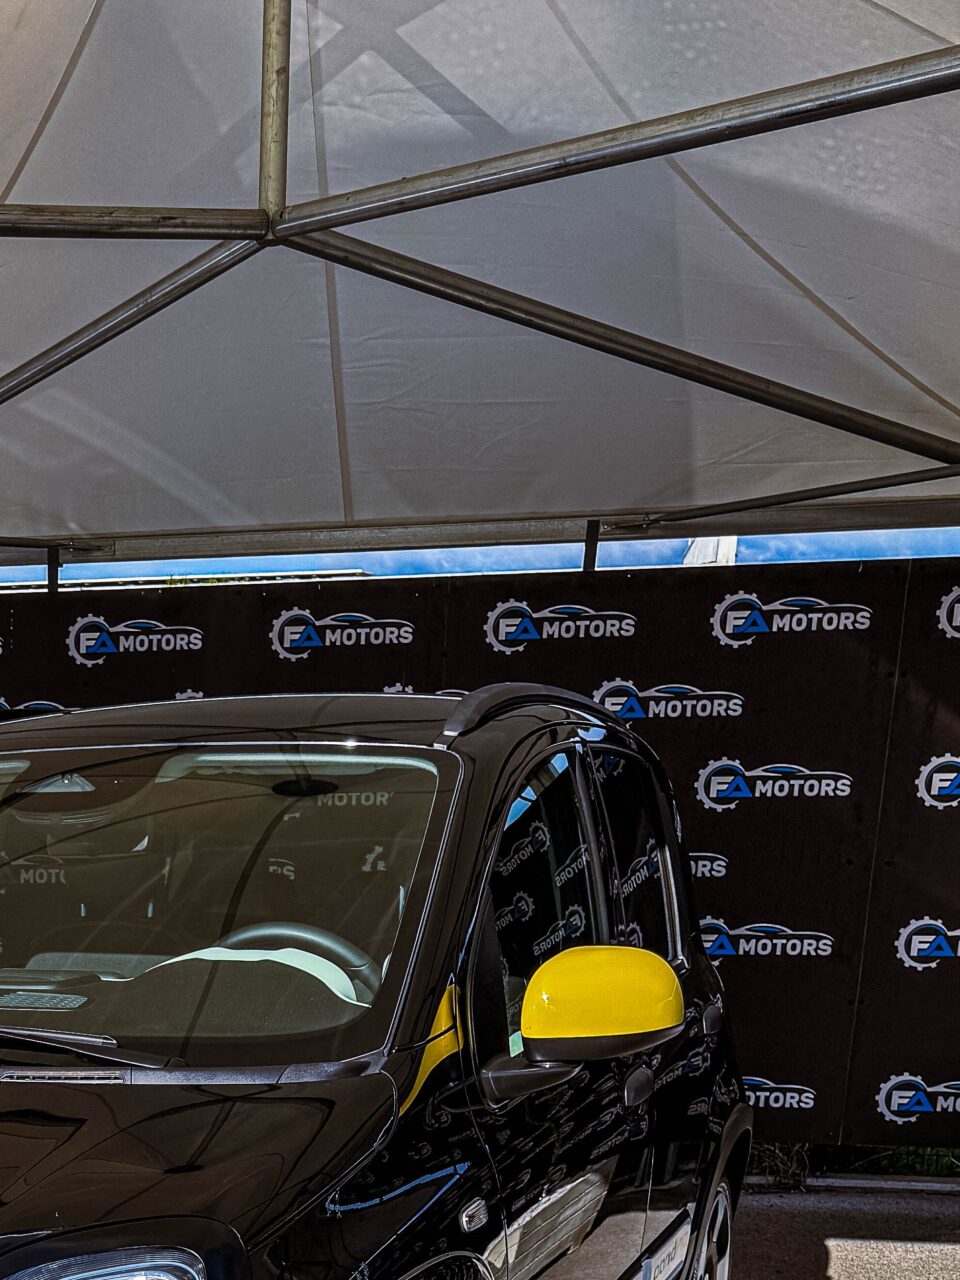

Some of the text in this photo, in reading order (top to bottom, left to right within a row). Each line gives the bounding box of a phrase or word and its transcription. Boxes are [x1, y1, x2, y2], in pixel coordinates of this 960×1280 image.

[498, 617, 636, 641] FA MOTORS
[725, 609, 872, 634] FA MOTORS
[79, 631, 203, 654] FA MOTORS
[284, 624, 414, 647] FA MOTORS
[604, 696, 743, 719] FA MOTORS
[710, 774, 852, 798] FA MOTORS
[318, 792, 393, 807] MOTOR
[738, 938, 833, 956] MOTORS
[910, 934, 956, 957] FA
[745, 1091, 815, 1109] OTORS
[890, 1090, 935, 1112] FA
